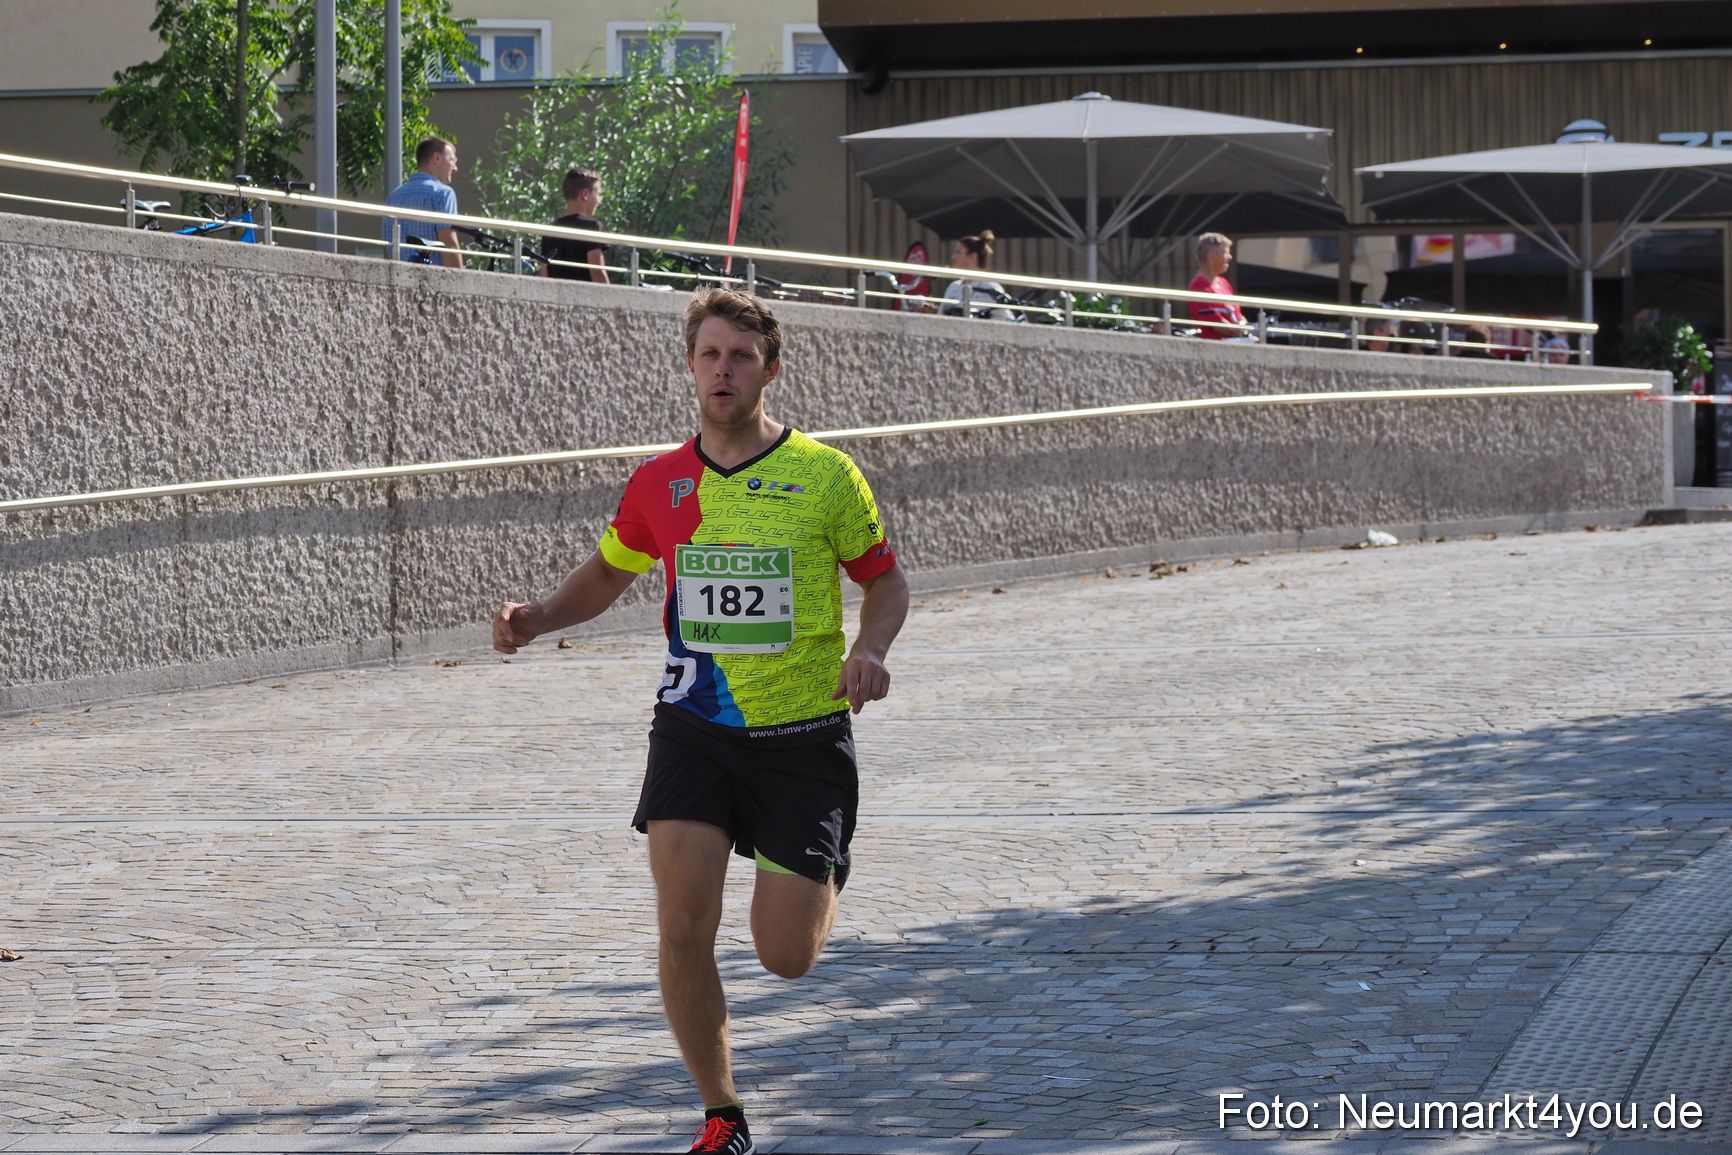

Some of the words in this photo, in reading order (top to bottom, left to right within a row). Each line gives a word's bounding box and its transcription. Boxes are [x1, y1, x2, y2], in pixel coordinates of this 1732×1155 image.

[669, 478, 695, 508] P
[684, 552, 779, 574] BOCK
[699, 585, 765, 616] 182
